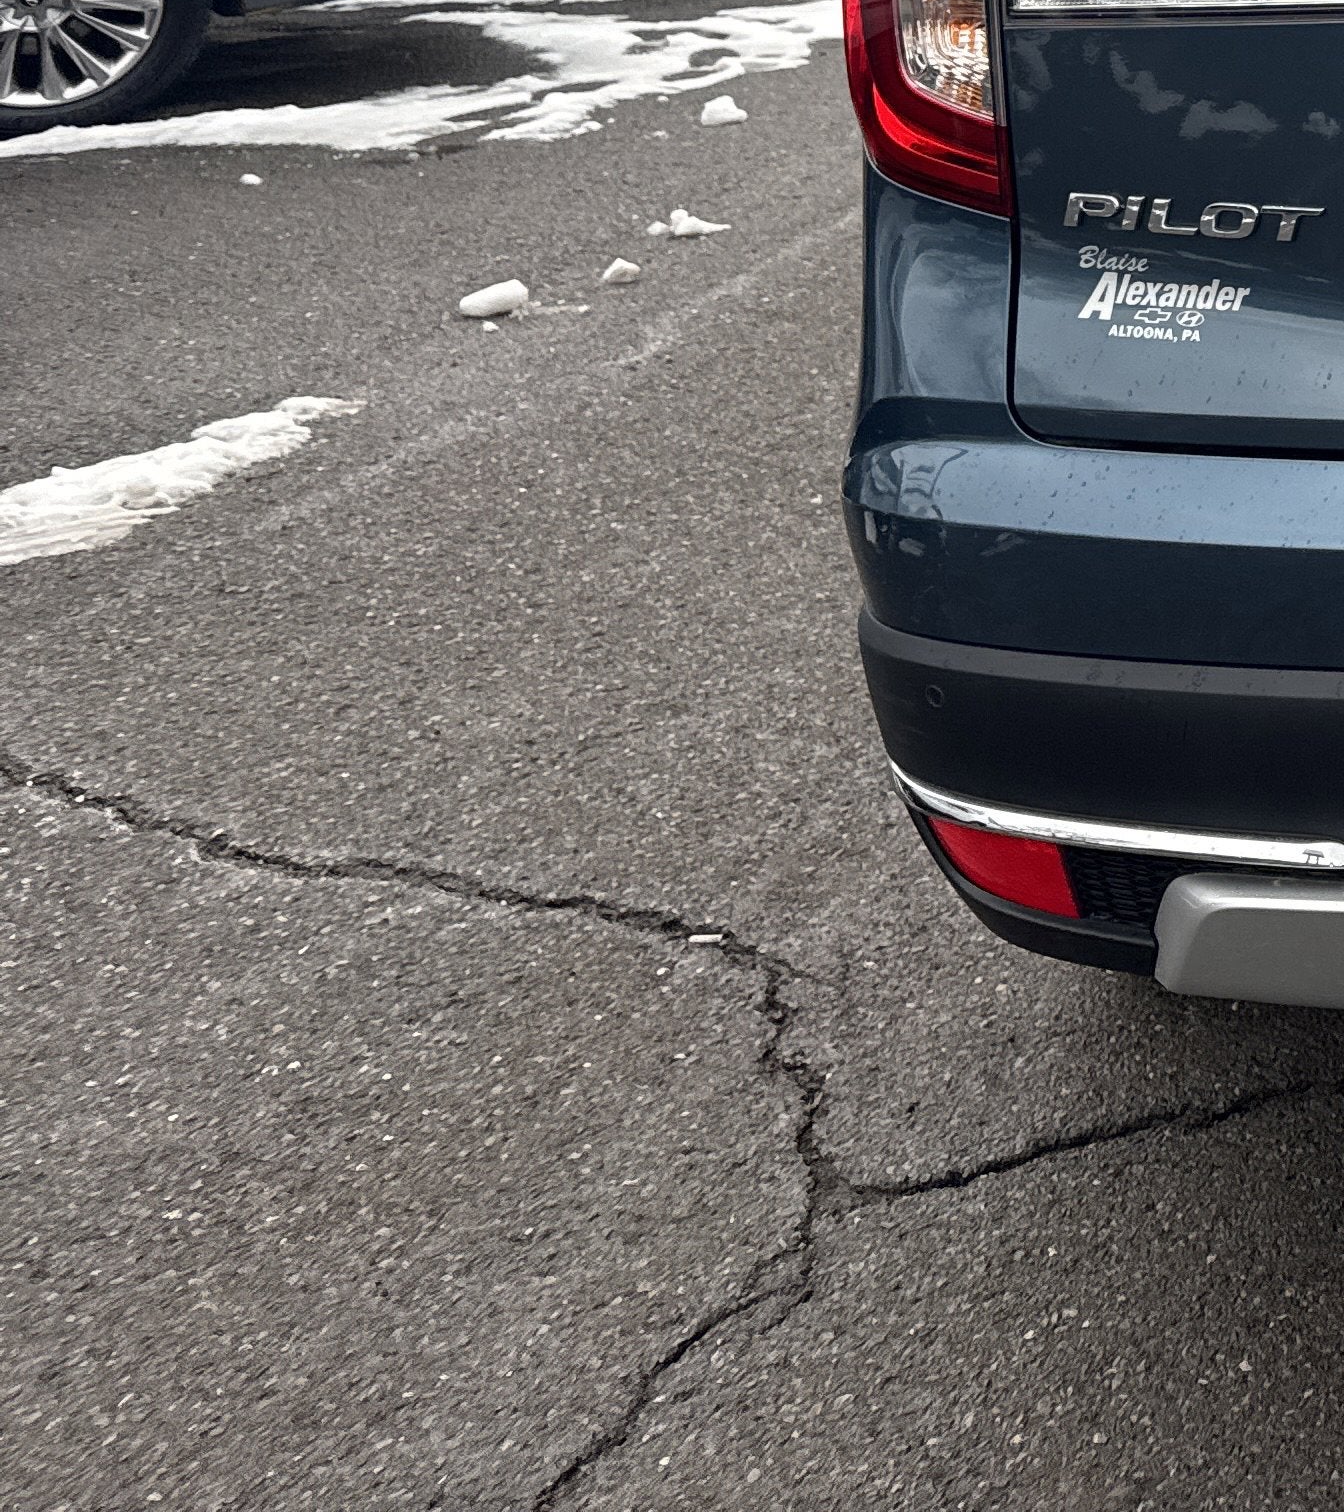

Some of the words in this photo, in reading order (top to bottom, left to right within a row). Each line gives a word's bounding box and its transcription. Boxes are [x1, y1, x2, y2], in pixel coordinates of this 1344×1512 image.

[1063, 192, 1325, 240] PILOT
[1078, 245, 1149, 272] Blaise
[1078, 271, 1250, 320] Alexander
[1108, 324, 1178, 343] ALTOONA,
[1181, 329, 1201, 342] PA
